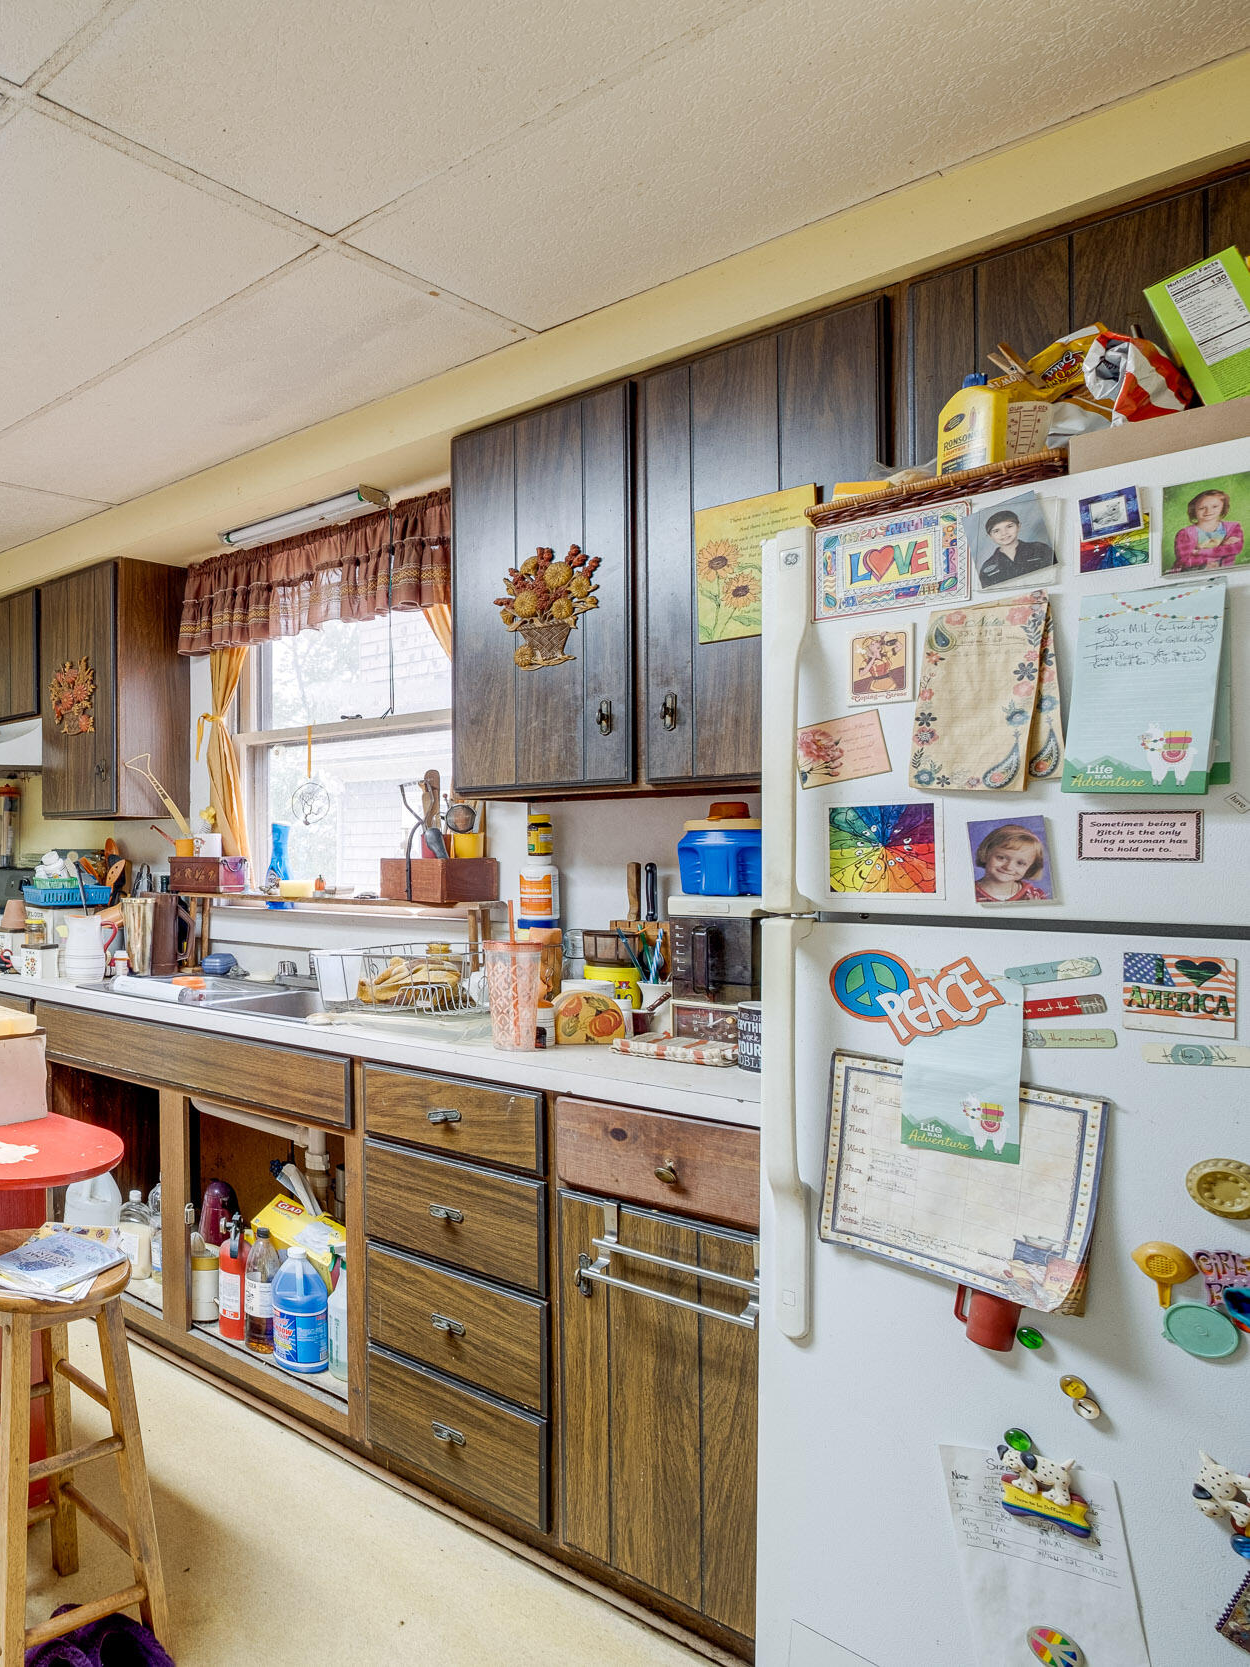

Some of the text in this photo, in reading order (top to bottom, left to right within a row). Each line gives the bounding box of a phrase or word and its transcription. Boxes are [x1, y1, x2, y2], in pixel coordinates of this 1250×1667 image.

[1167, 261, 1219, 288] Nutrition Facts
[1174, 274, 1227, 303] Calories 130
[1086, 765, 1114, 774] Life
[1070, 773, 1145, 788] Adventure
[1230, 795, 1246, 809] have
[1155, 957, 1166, 985] I
[875, 961, 1000, 1040] PEACE
[1037, 1002, 1053, 1012] out
[1055, 1001, 1070, 1010] the
[1127, 985, 1232, 1017] AMERICA
[853, 1085, 871, 1094] Sun.
[920, 1122, 942, 1133] Life
[908, 1129, 971, 1151] Adventure
[277, 1201, 303, 1215] GLAD
